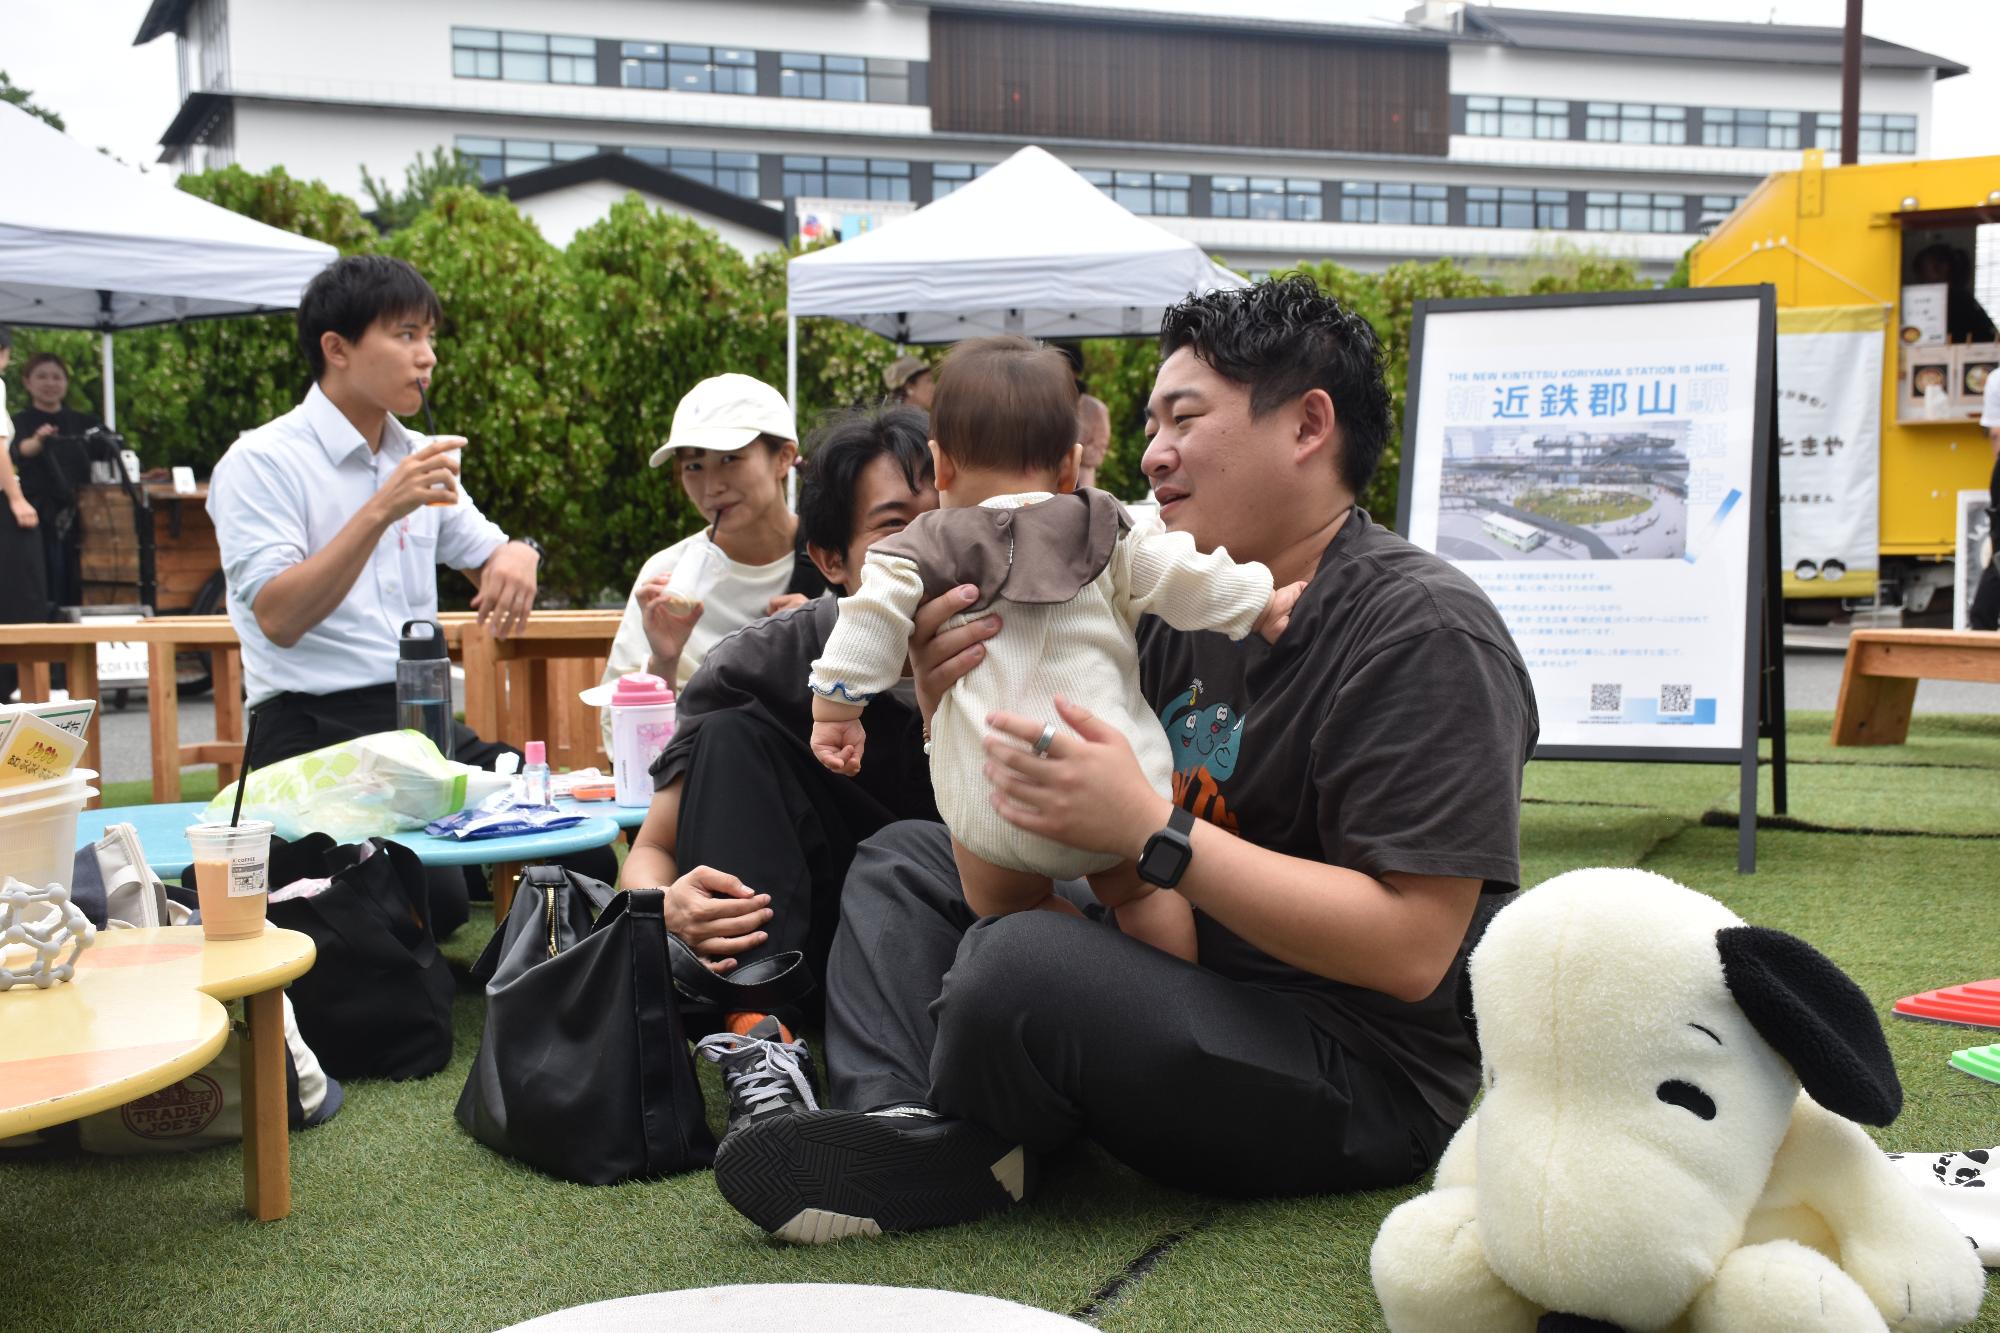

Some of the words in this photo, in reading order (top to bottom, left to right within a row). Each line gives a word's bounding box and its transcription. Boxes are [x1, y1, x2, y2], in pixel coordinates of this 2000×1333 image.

[1448, 372, 1468, 382] THE
[1472, 371, 1498, 381] NEW
[1502, 369, 1558, 380] KINTETSU
[1562, 367, 1622, 378] KORIYAMA
[1626, 366, 1676, 376] STATION
[1680, 364, 1691, 374] IS
[1695, 363, 1729, 373] HERE.
[1492, 380, 1678, 418] 近鉄郡山
[132, 1102, 211, 1123] TRADER
[147, 1116, 203, 1133] JOE'S
